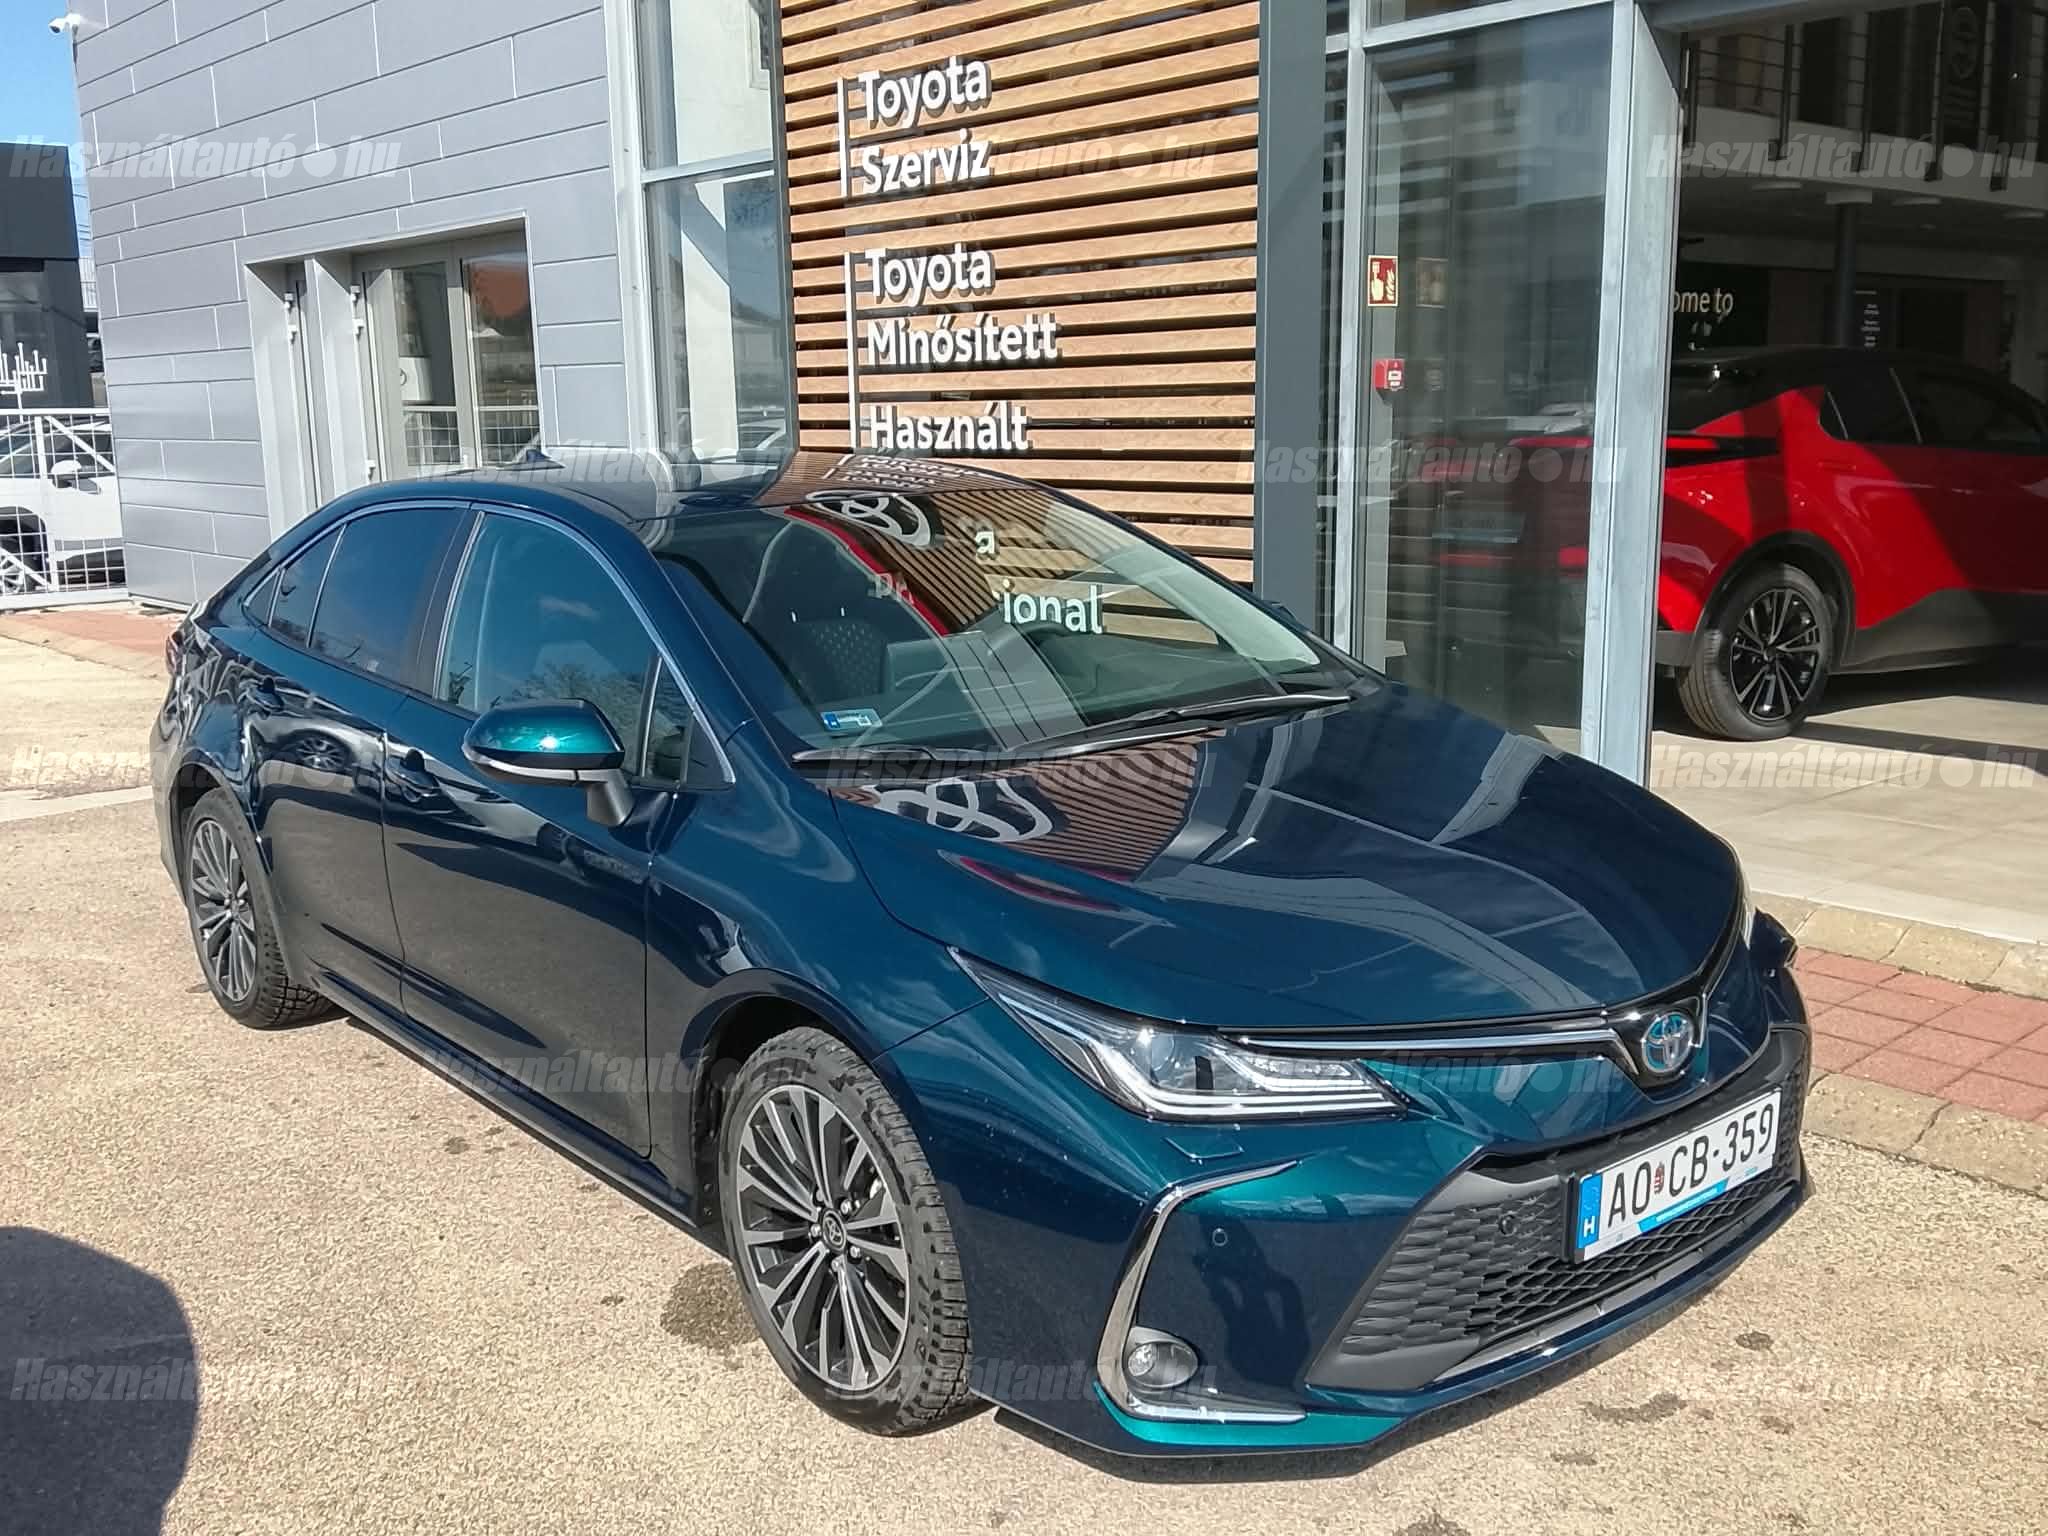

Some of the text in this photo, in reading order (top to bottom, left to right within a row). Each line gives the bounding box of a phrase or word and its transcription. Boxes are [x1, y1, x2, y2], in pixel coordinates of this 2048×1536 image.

[858, 55, 988, 129] Toyota
[862, 128, 991, 194] Szerviz
[865, 242, 993, 308] Toyota
[1714, 287, 1734, 314] to
[867, 313, 1060, 366] Minősített
[869, 401, 1029, 450] Használt
